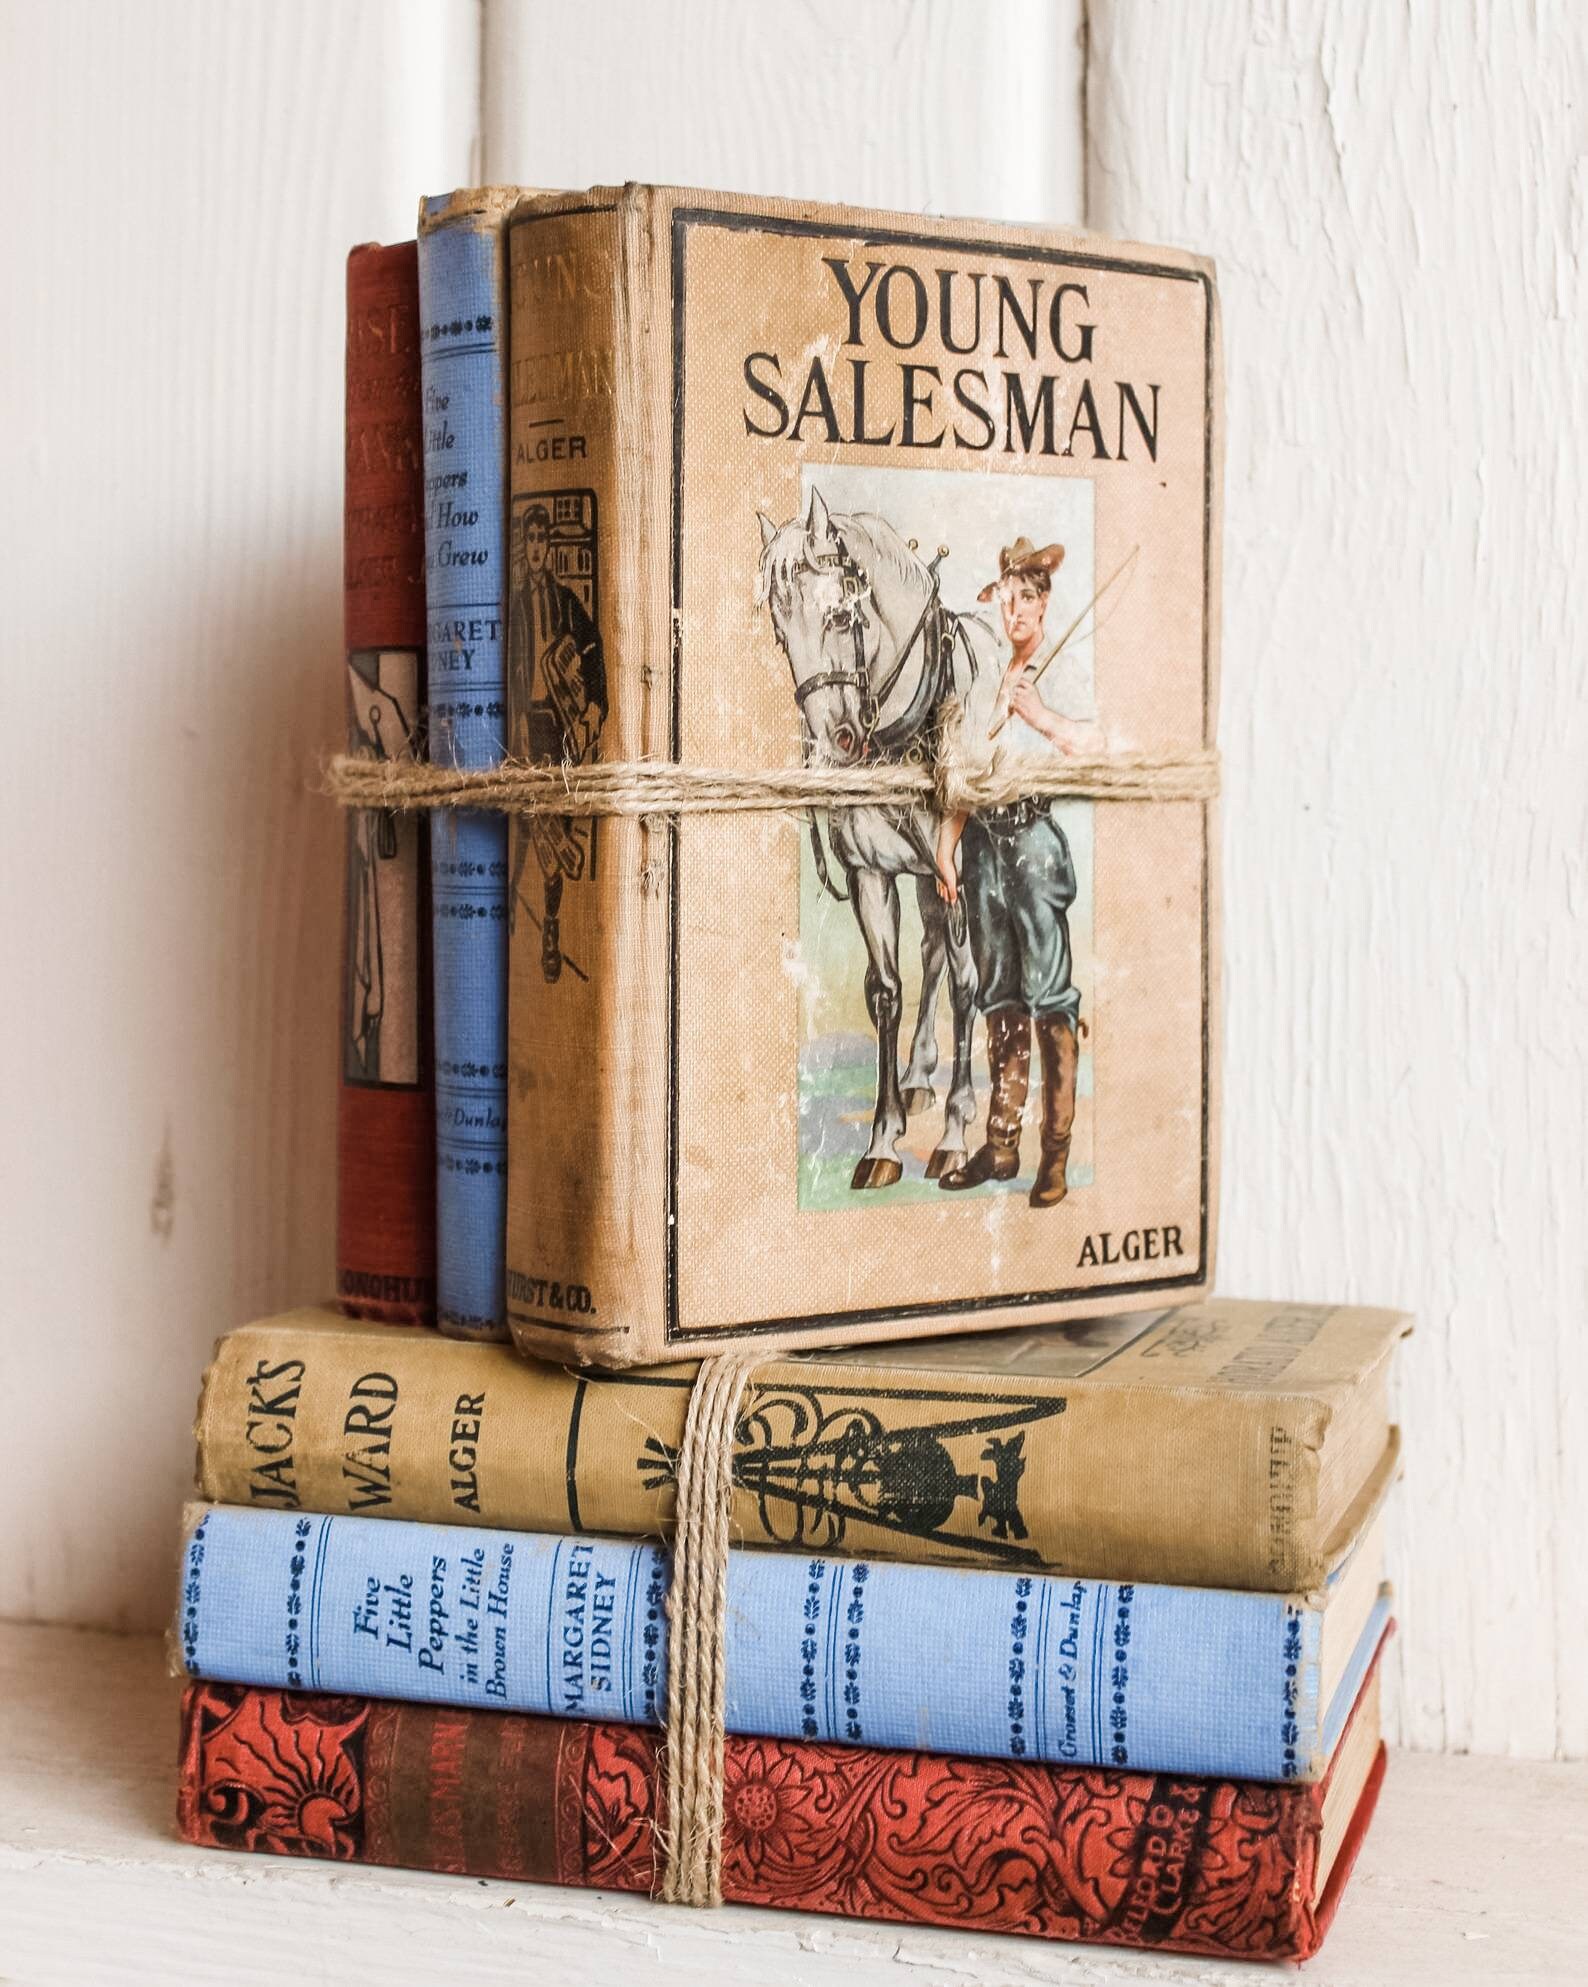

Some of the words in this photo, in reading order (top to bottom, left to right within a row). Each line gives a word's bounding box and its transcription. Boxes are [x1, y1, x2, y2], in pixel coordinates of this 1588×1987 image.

[822, 258, 1096, 363] YOUNG
[743, 352, 1161, 463] SALESMAN
[516, 436, 588, 464] ALGER
[437, 501, 479, 529] How
[438, 540, 489, 568] Grew
[431, 620, 501, 642] GARET
[437, 648, 475, 671] NEY
[1076, 1225, 1184, 1268] ALGER
[549, 1281, 564, 1310] &
[246, 1359, 306, 1508] JACK'S
[343, 1372, 398, 1511] WARD
[449, 1391, 486, 1513] ALGER
[352, 1576, 381, 1640] Five
[383, 1574, 413, 1653] Little
[418, 1554, 449, 1675] Peppers
[459, 1547, 485, 1610] Little
[487, 1542, 514, 1619] House
[454, 1617, 479, 1655] the
[562, 1544, 594, 1713] MARGARET
[590, 1571, 617, 1692] SIDNEY
[1059, 1580, 1087, 1661] Dunlap
[459, 1662, 479, 1684] in
[485, 1626, 508, 1700] Brown
